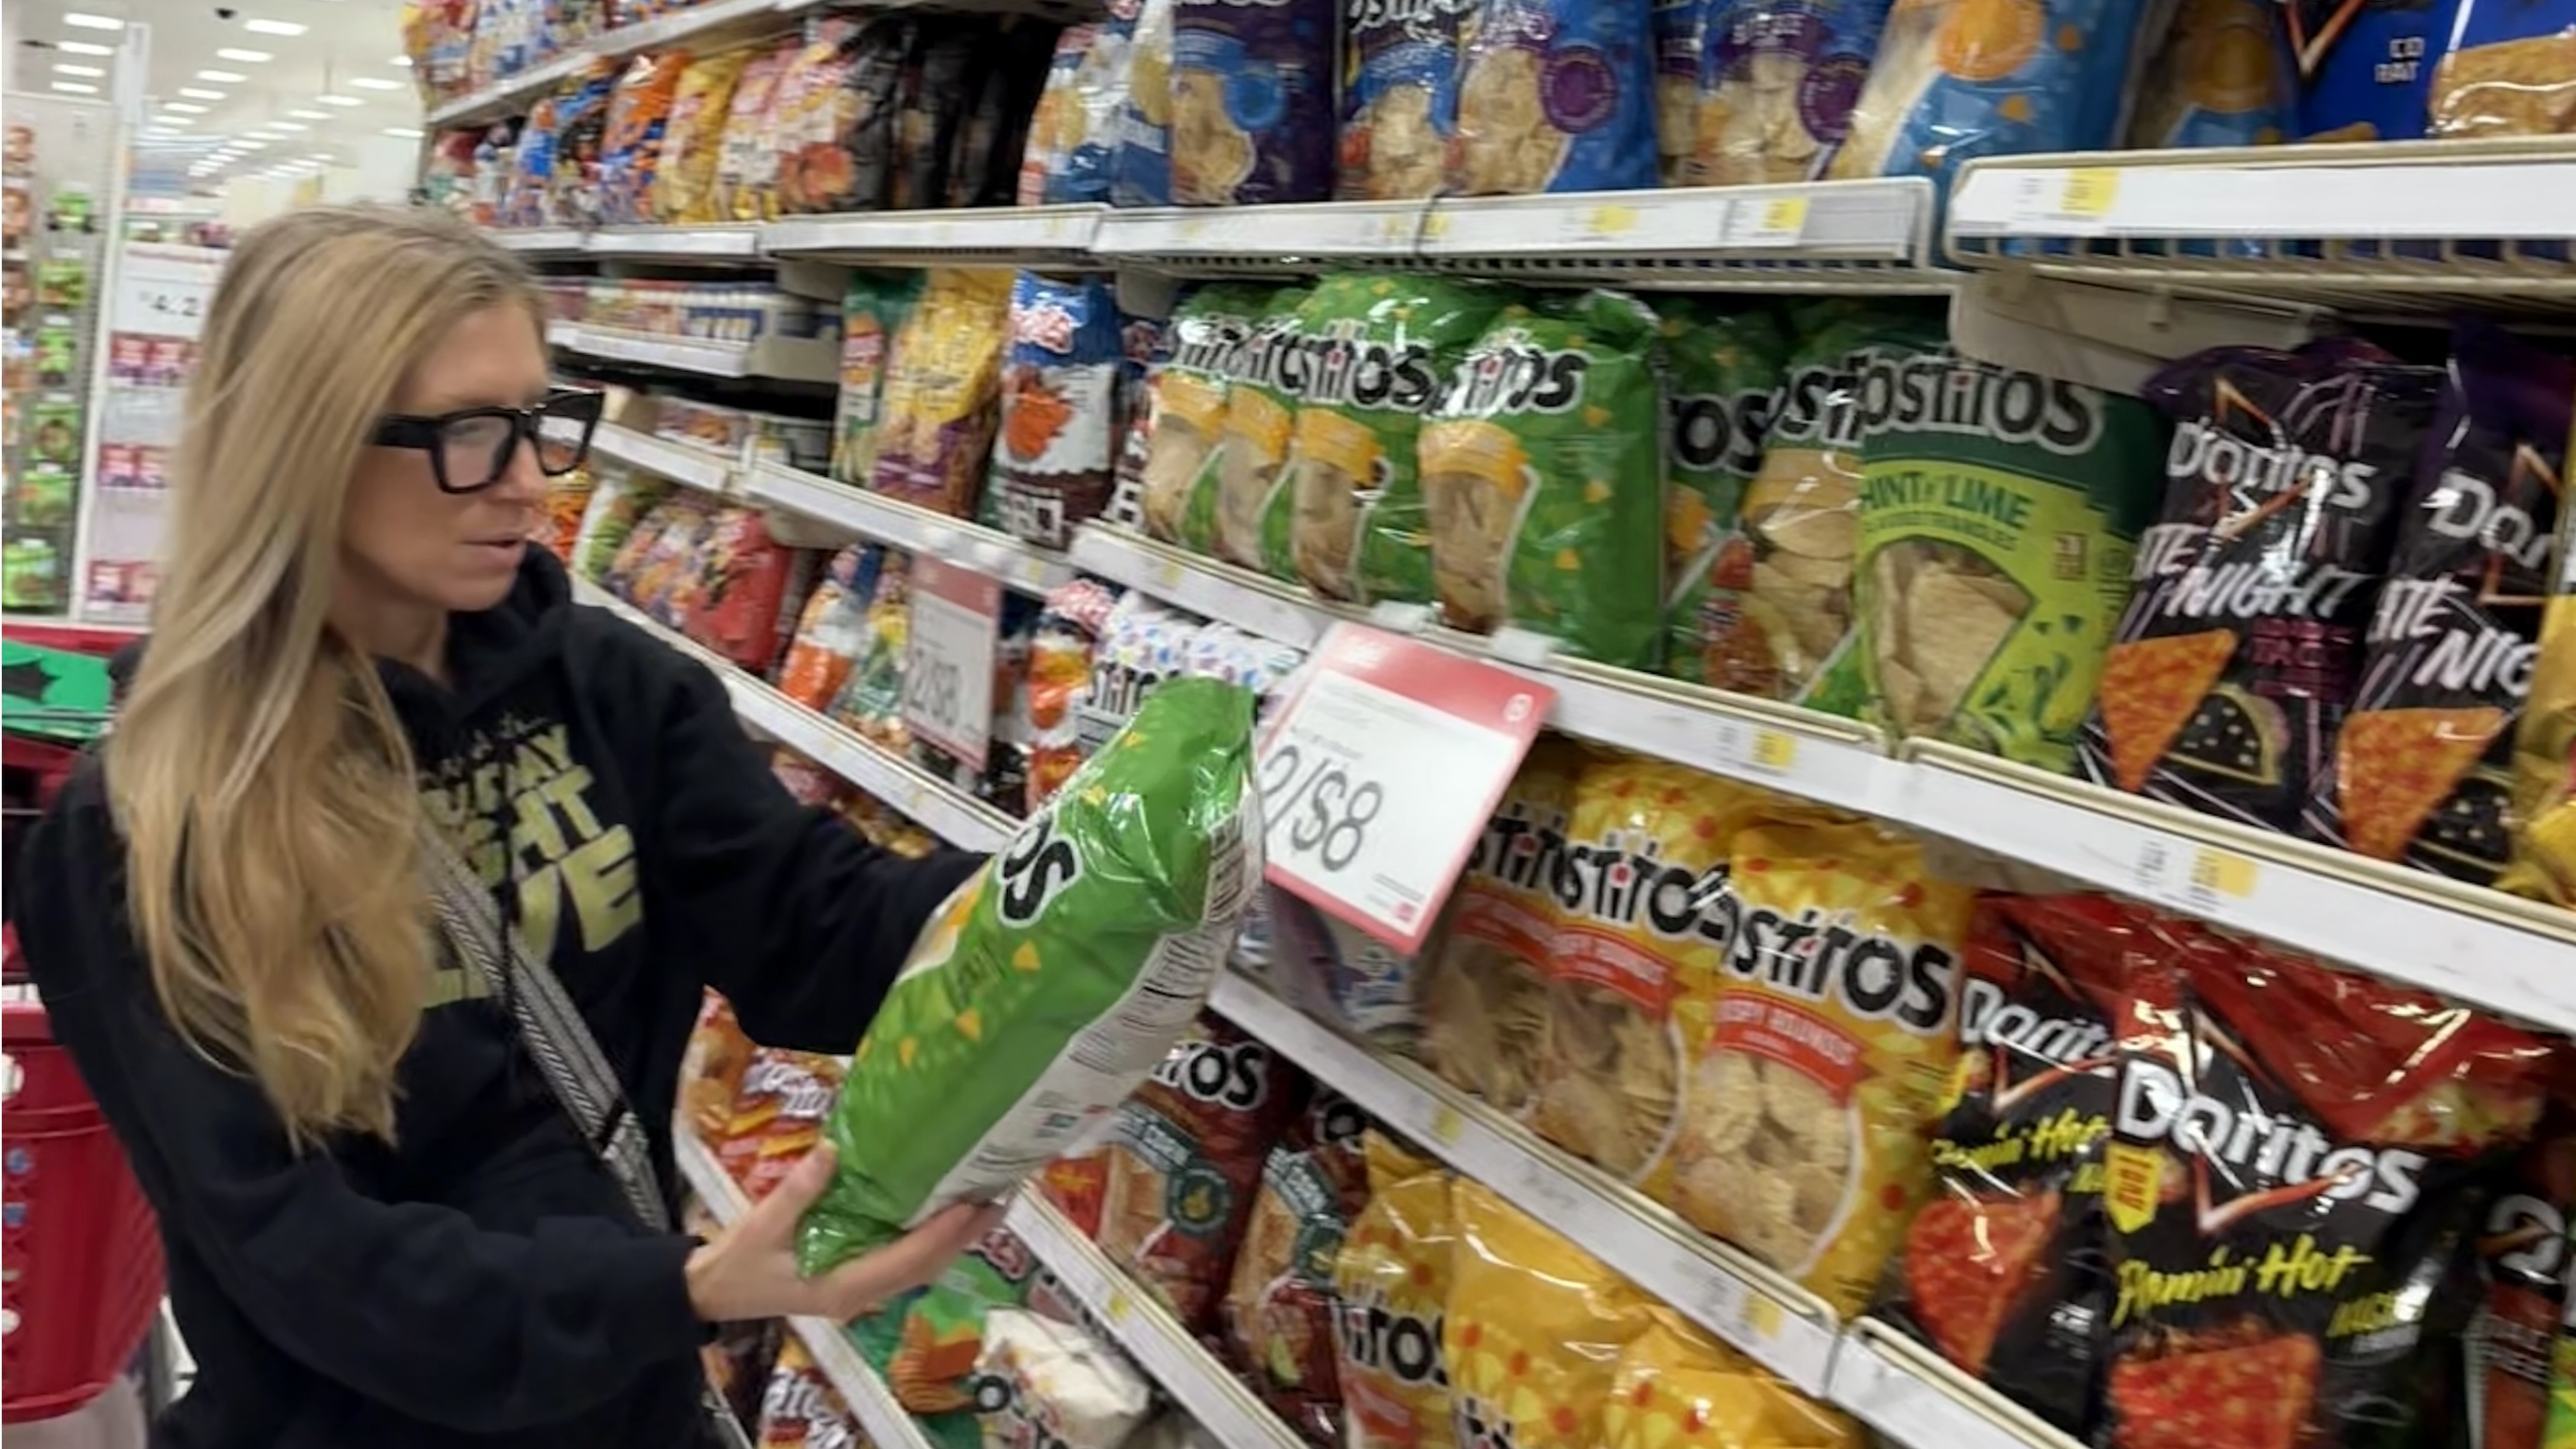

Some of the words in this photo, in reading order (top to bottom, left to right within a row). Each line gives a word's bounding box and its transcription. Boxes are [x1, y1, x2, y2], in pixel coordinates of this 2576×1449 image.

[2167, 415, 2379, 508] Doritos
[2428, 464, 2553, 570] Dor
[1262, 744, 1384, 873] 2/$8
[2114, 1057, 2432, 1214] Doritos
[2254, 1233, 2375, 1299] Hot
